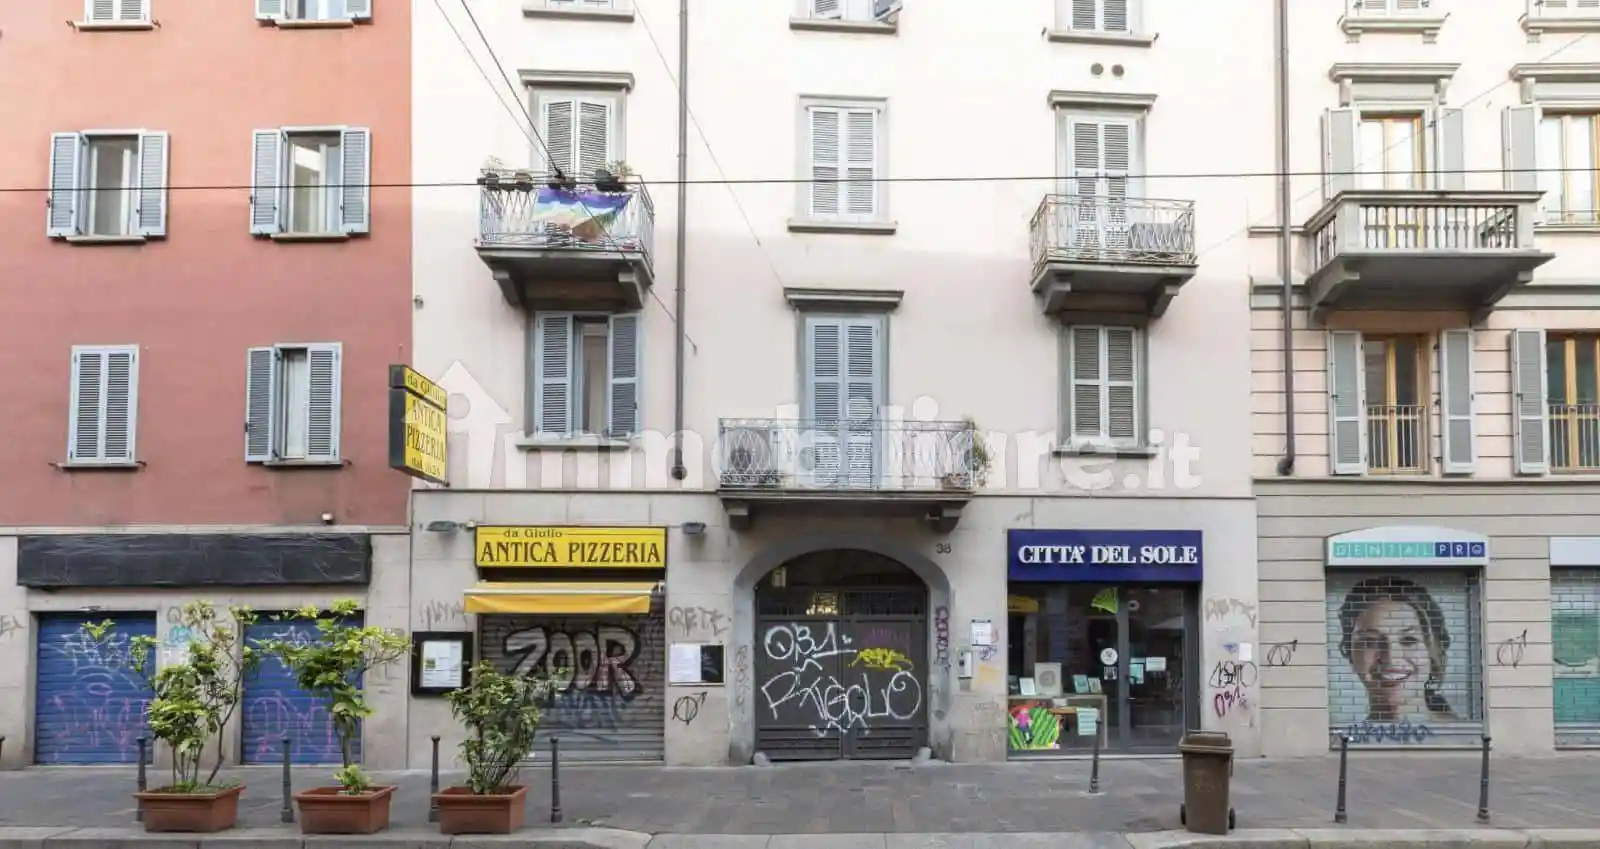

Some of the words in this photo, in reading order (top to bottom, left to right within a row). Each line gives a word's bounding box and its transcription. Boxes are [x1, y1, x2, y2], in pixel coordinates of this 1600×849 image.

[411, 399, 443, 434] ANTICA
[406, 425, 445, 463] PIZZERIA
[503, 529, 519, 538] da
[524, 528, 563, 539] Giulio
[480, 542, 559, 563] ANTICA
[568, 542, 661, 563] PIZZERIA
[935, 542, 952, 555] 38
[1018, 545, 1086, 564] CITTA'
[1090, 545, 1137, 564] DEL
[1140, 545, 1198, 564] SOLE
